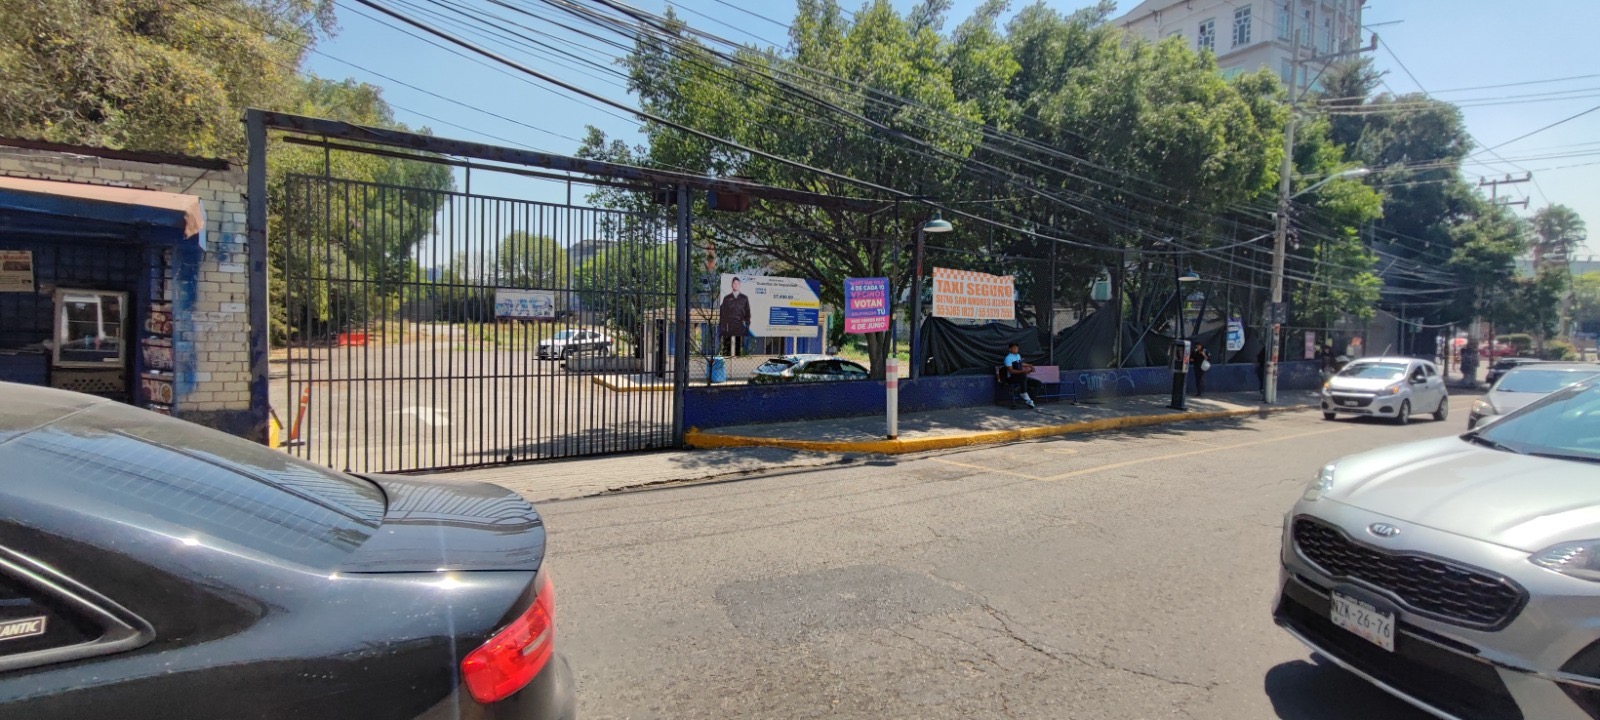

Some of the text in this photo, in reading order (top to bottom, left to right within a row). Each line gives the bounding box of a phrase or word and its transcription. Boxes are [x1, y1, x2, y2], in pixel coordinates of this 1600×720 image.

[936, 280, 1013, 297] TAXI SEGURO
[851, 290, 885, 298] VECINOS
[854, 299, 882, 308] VOTAN
[954, 295, 966, 305] SAN
[876, 307, 885, 315] TÚ
[936, 304, 944, 315] 55
[1372, 523, 1392, 536] KIA
[0, 620, 40, 637] ANTIC
